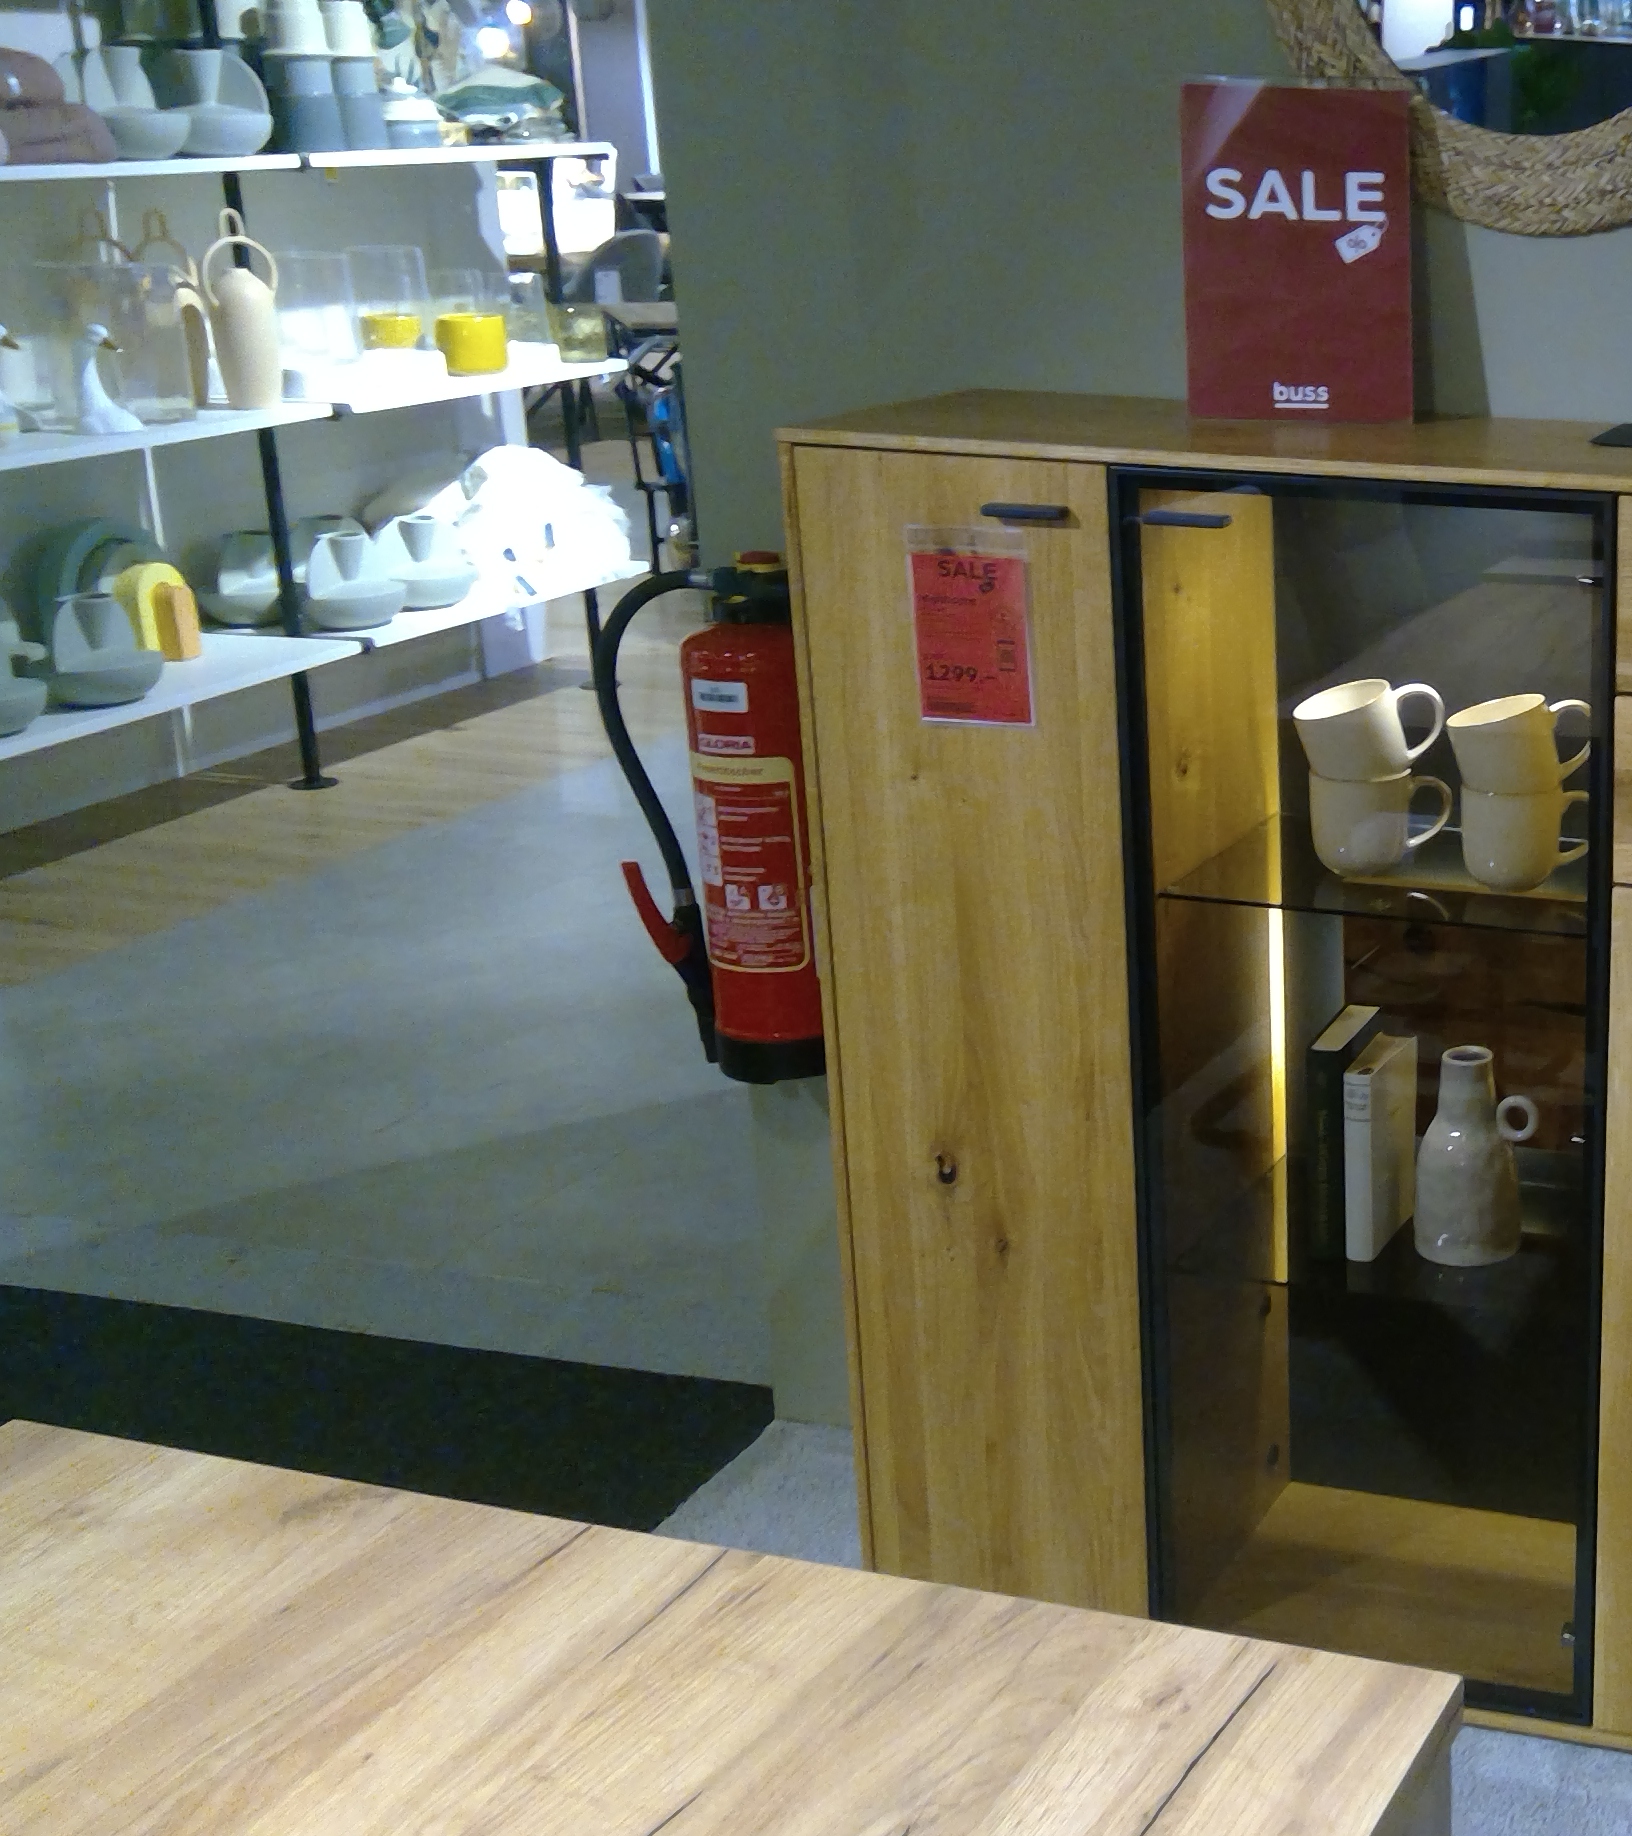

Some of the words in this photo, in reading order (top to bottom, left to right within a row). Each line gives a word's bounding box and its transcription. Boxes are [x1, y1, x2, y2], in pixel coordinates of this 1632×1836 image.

[1205, 167, 1388, 222] SALE
[1273, 381, 1330, 401] buss
[936, 559, 998, 580] SALE
